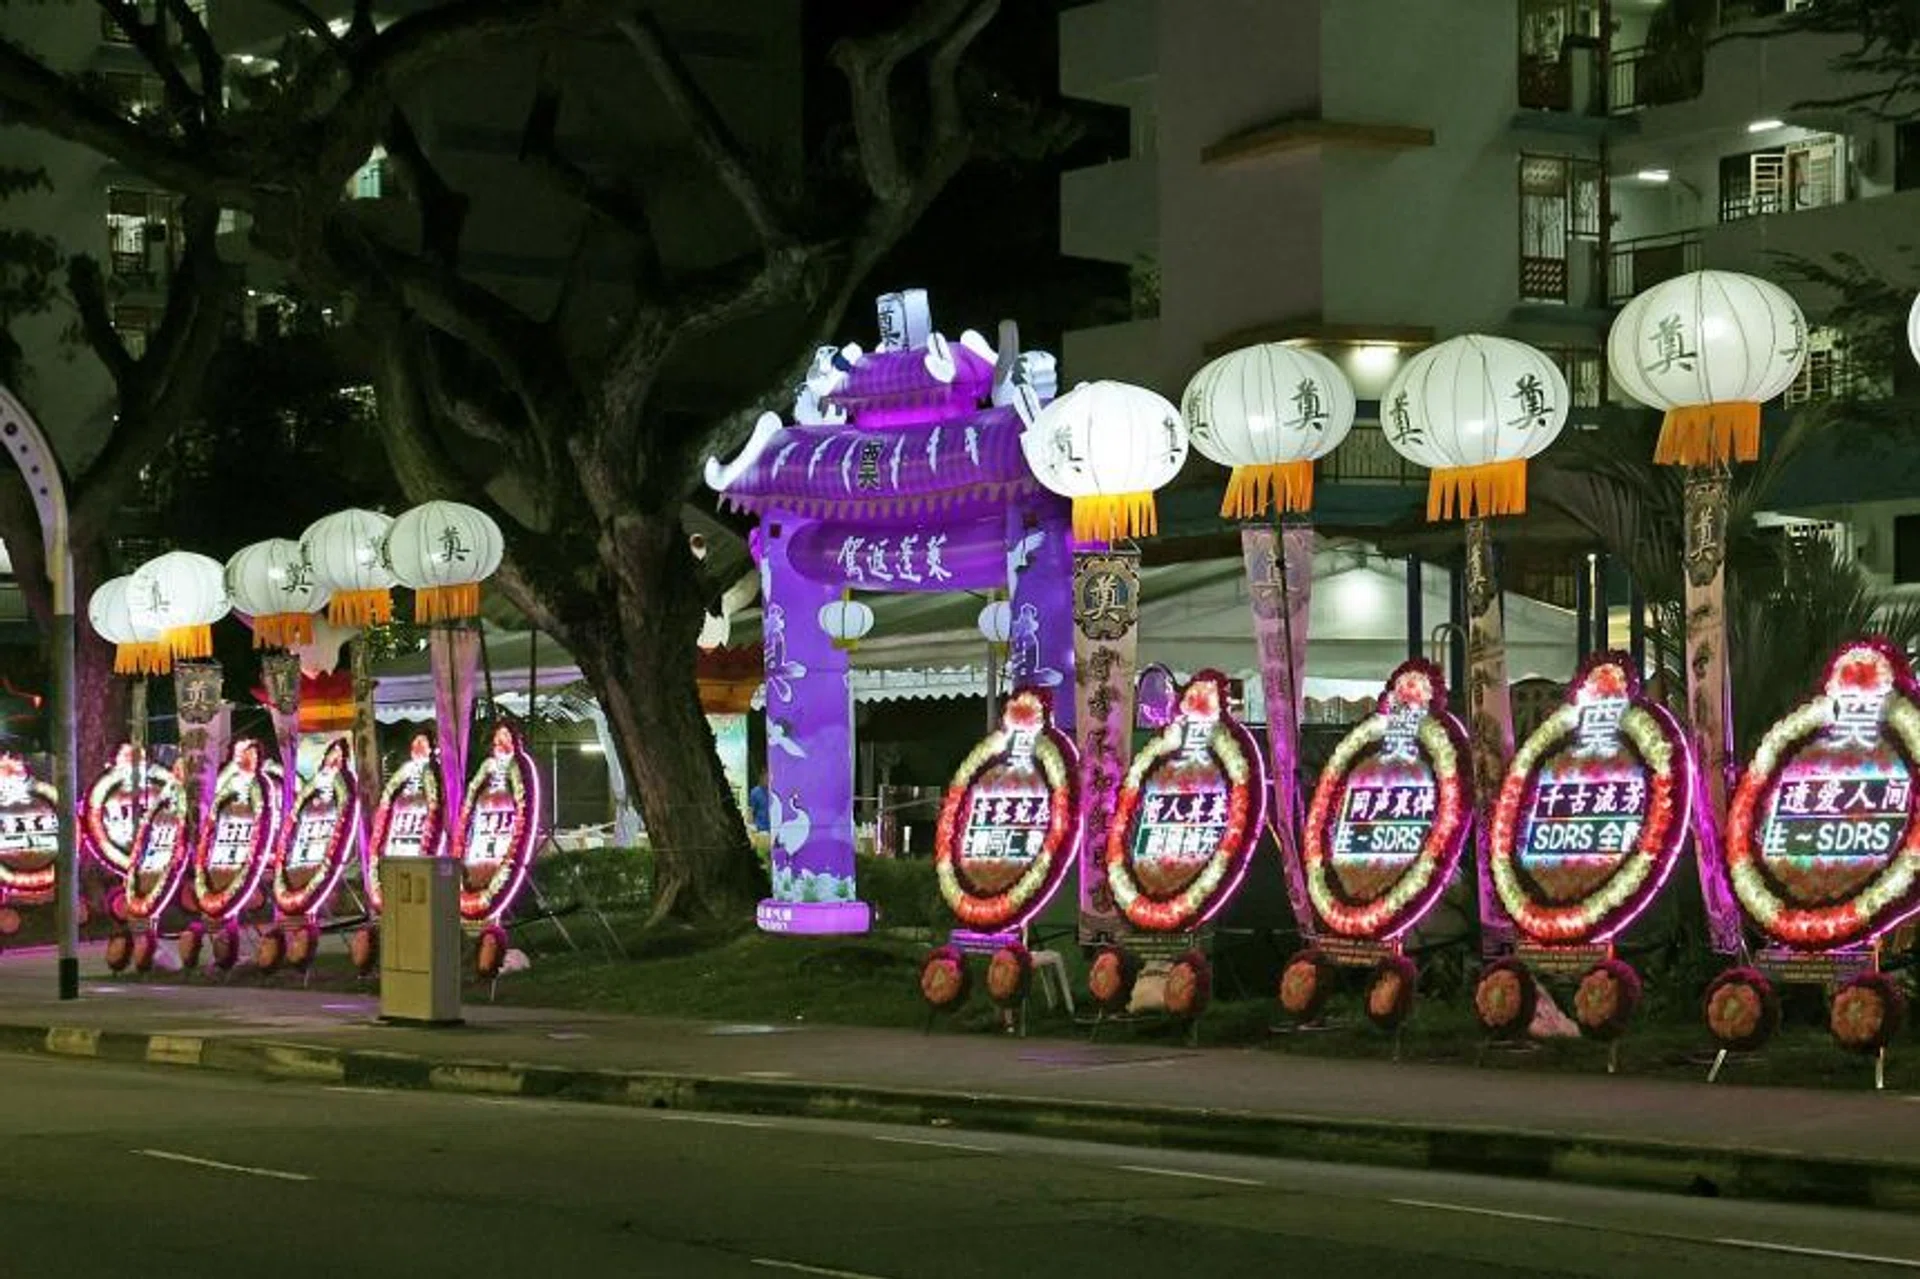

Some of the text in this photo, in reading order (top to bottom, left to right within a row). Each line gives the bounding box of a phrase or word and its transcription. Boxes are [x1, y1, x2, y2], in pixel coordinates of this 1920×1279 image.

[1645, 313, 1698, 374] 奠
[1283, 377, 1329, 431] 奠
[1389, 390, 1424, 445] 奠
[1507, 373, 1554, 430] 奠
[438, 526, 470, 562] 奠
[1689, 505, 1717, 562] 奠
[1083, 575, 1126, 622] 奠
[1540, 780, 1645, 815] 千古流芳
[1371, 826, 1423, 850] SDRS
[1534, 822, 1595, 850] SDRS
[1816, 822, 1890, 851] SDRS
